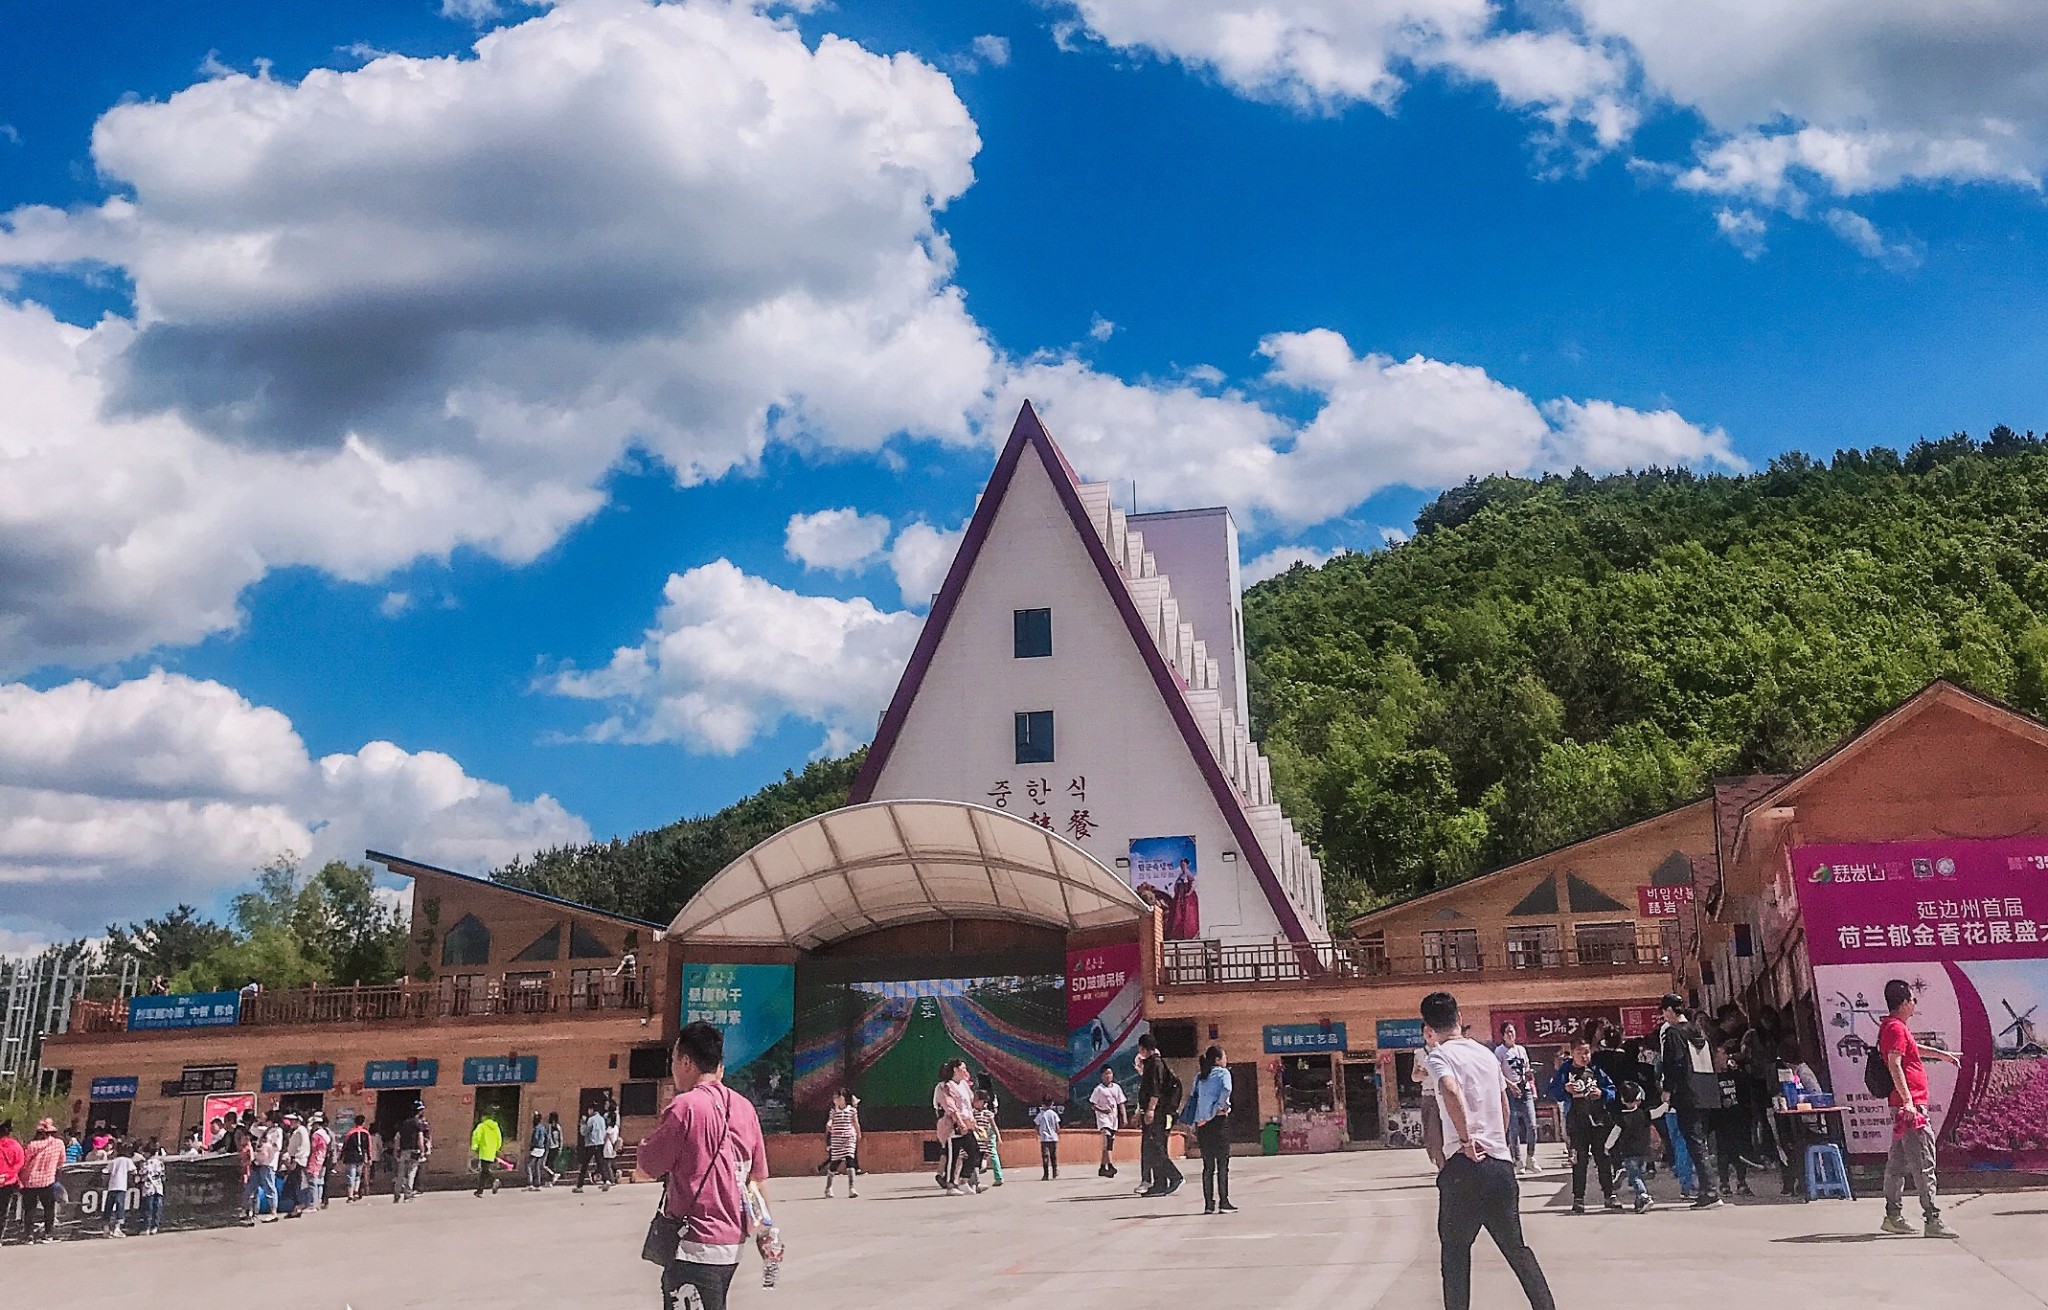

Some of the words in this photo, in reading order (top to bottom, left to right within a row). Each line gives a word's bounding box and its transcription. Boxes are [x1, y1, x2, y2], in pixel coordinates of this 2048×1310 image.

[1916, 897, 2024, 920] 延边州首届
